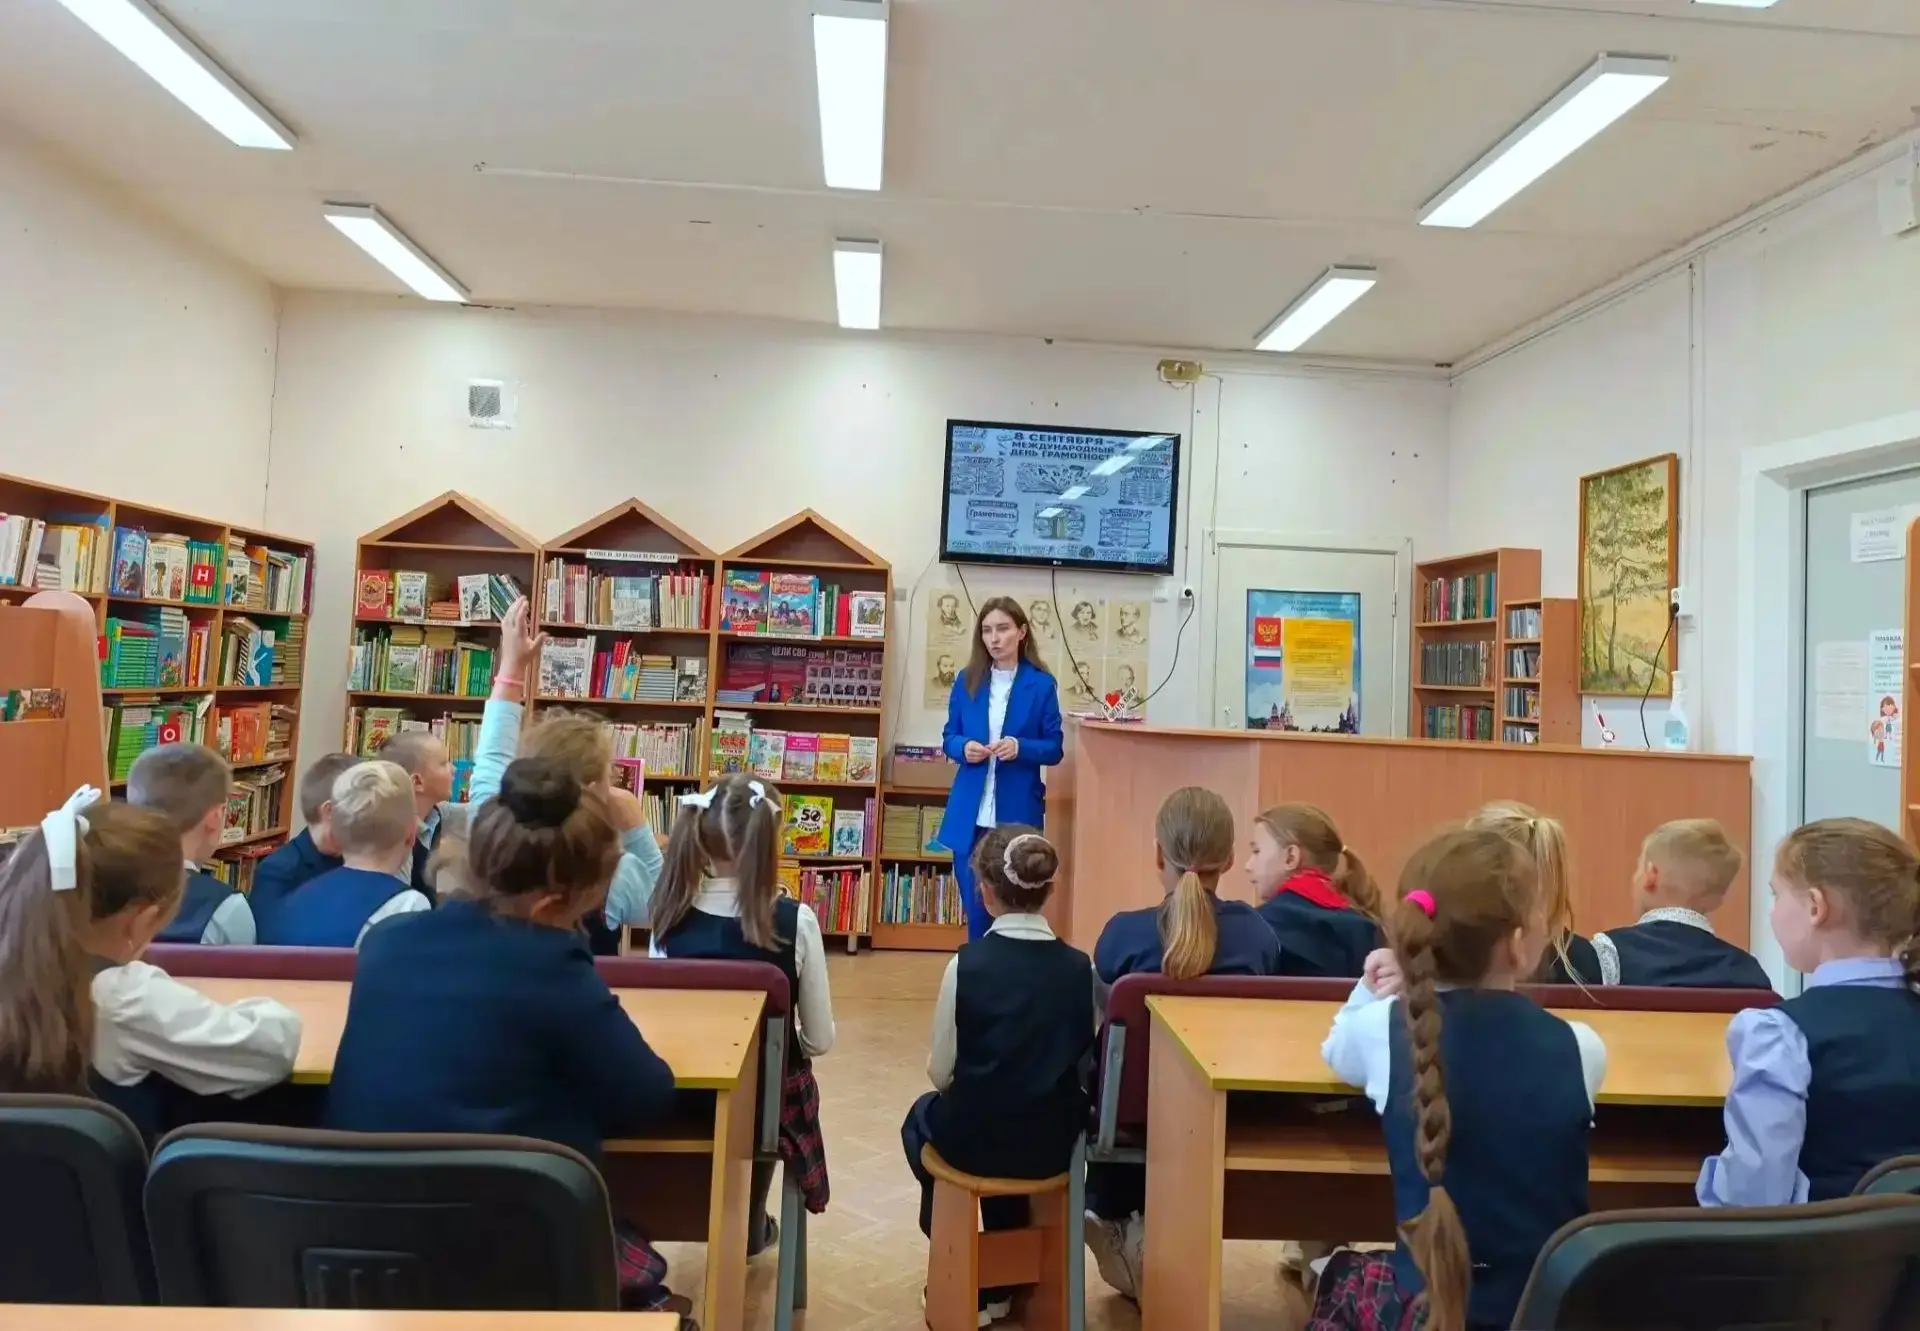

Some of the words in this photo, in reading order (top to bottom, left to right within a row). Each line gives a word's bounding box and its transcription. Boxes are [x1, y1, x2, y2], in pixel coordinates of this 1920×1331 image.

[1014, 432, 1023, 441] 8
[1028, 433, 1104, 445] СЕНТЯБРЯ
[1009, 449, 1038, 457] ДЕНЬ
[1011, 441, 1115, 454] МЕЖДУНАРОДНЫЙ
[969, 508, 1016, 519] Грамотность
[771, 646, 792, 657] ЦЕЛИ
[792, 647, 807, 657] СВО
[801, 808, 821, 822] 50
